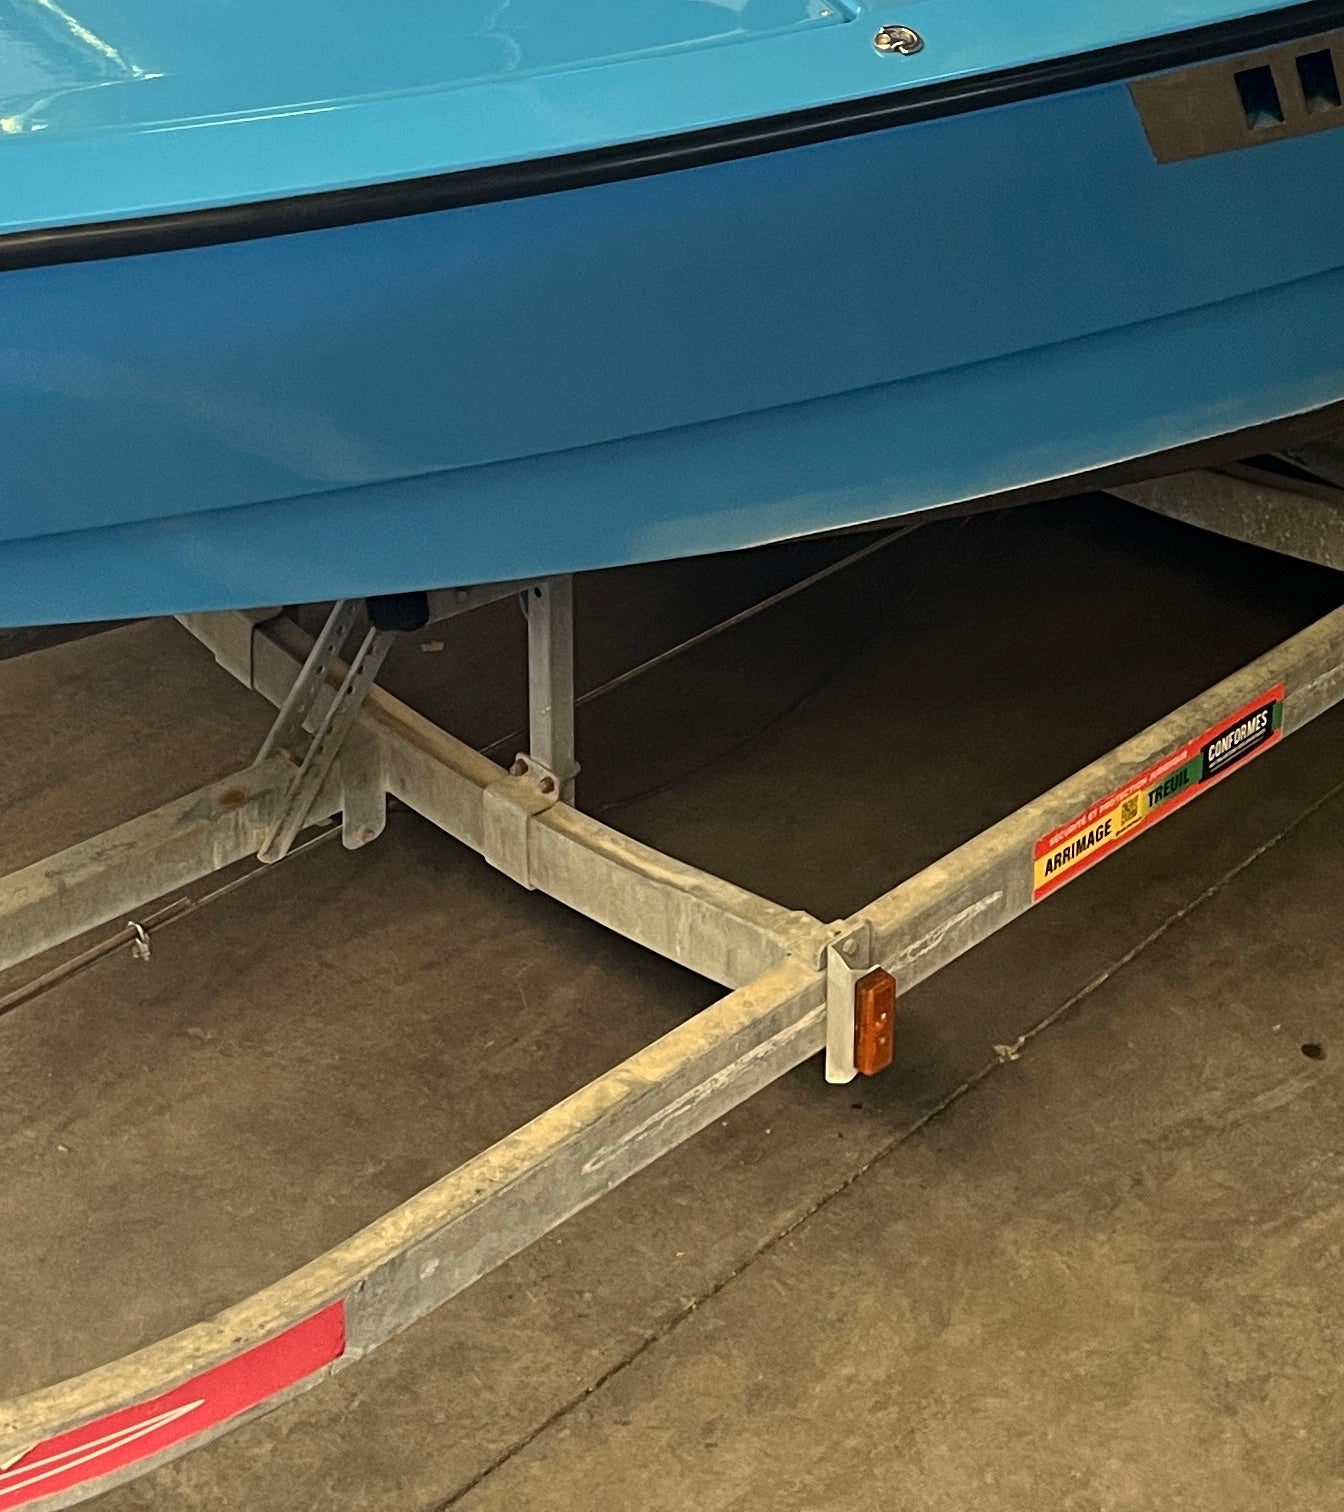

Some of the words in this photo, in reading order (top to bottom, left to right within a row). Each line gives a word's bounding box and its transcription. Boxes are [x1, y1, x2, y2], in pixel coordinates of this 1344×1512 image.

[1044, 818, 1113, 877] ARRIMAGE
[1147, 768, 1190, 808] TREUIL
[1208, 709, 1268, 762] CONFORMES
